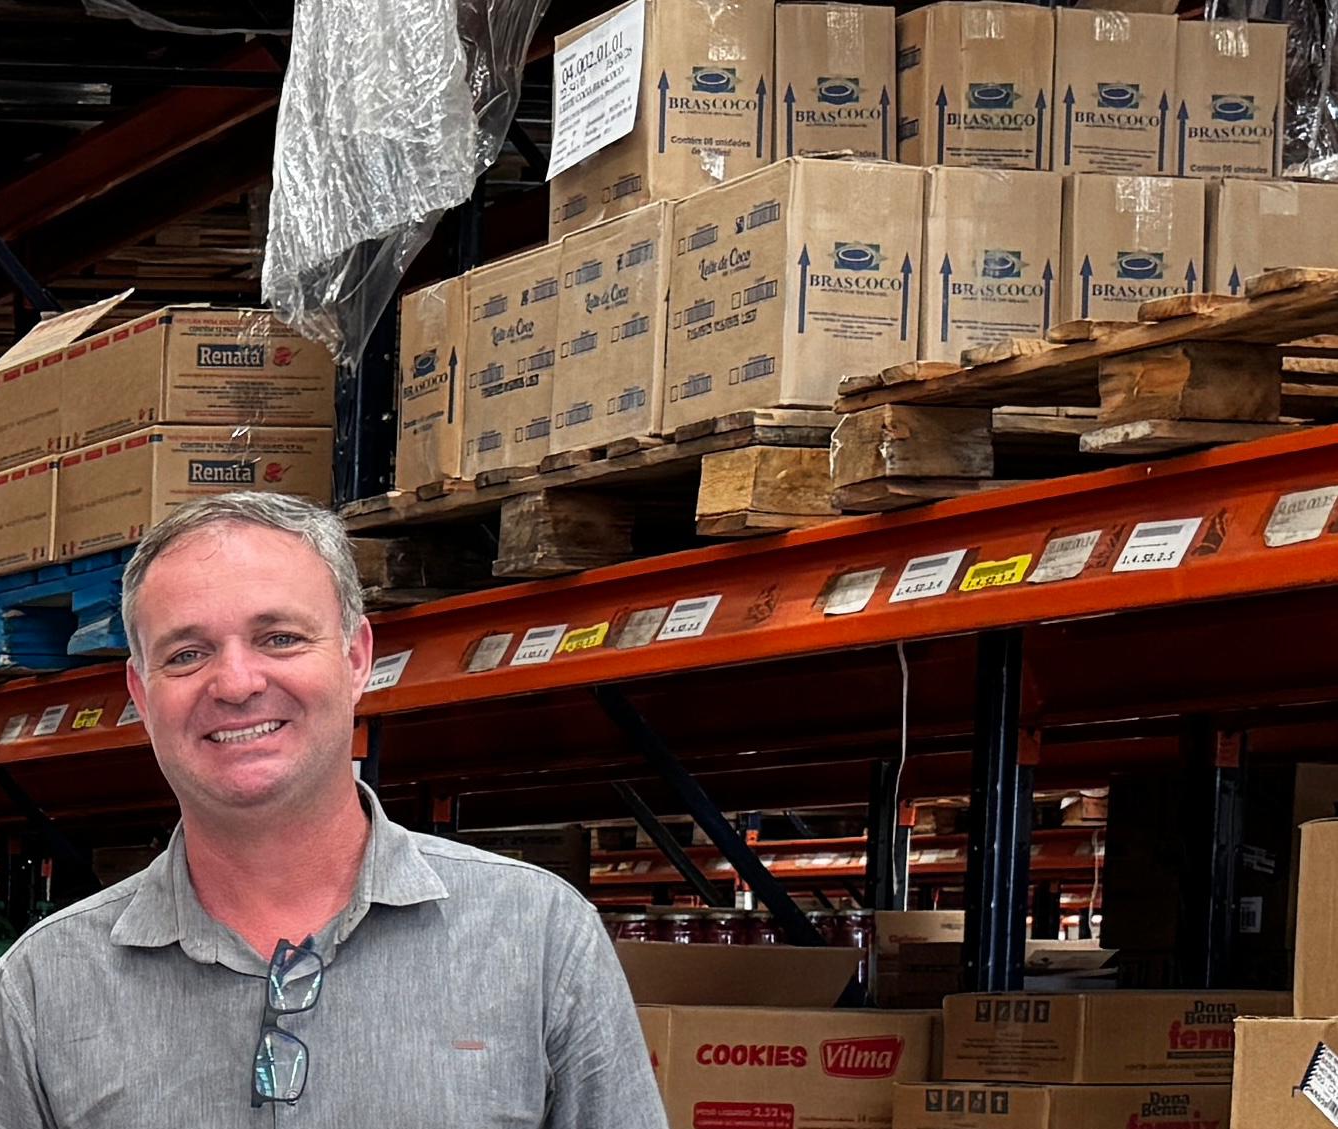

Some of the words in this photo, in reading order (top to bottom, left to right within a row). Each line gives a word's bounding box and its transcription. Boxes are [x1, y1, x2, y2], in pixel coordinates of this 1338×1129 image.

[669, 97, 757, 112] BRASCOCO
[795, 108, 880, 122] BRASCOCO
[947, 112, 1036, 126] BRASCOCO
[1075, 111, 1160, 127] BRASCOCO
[1188, 125, 1273, 139] BRASCOCO
[810, 274, 902, 290] BRASCOCO
[200, 346, 261, 365] Renata
[192, 463, 252, 481] Renata
[1194, 1001, 1237, 1015] Dona
[1185, 1011, 1235, 1025] Benta
[1169, 1021, 1234, 1049] ferm
[696, 1043, 808, 1068] COOKIES
[824, 1044, 894, 1070] Vilma
[1149, 1092, 1190, 1106] Dona
[1141, 1103, 1189, 1117] Benta
